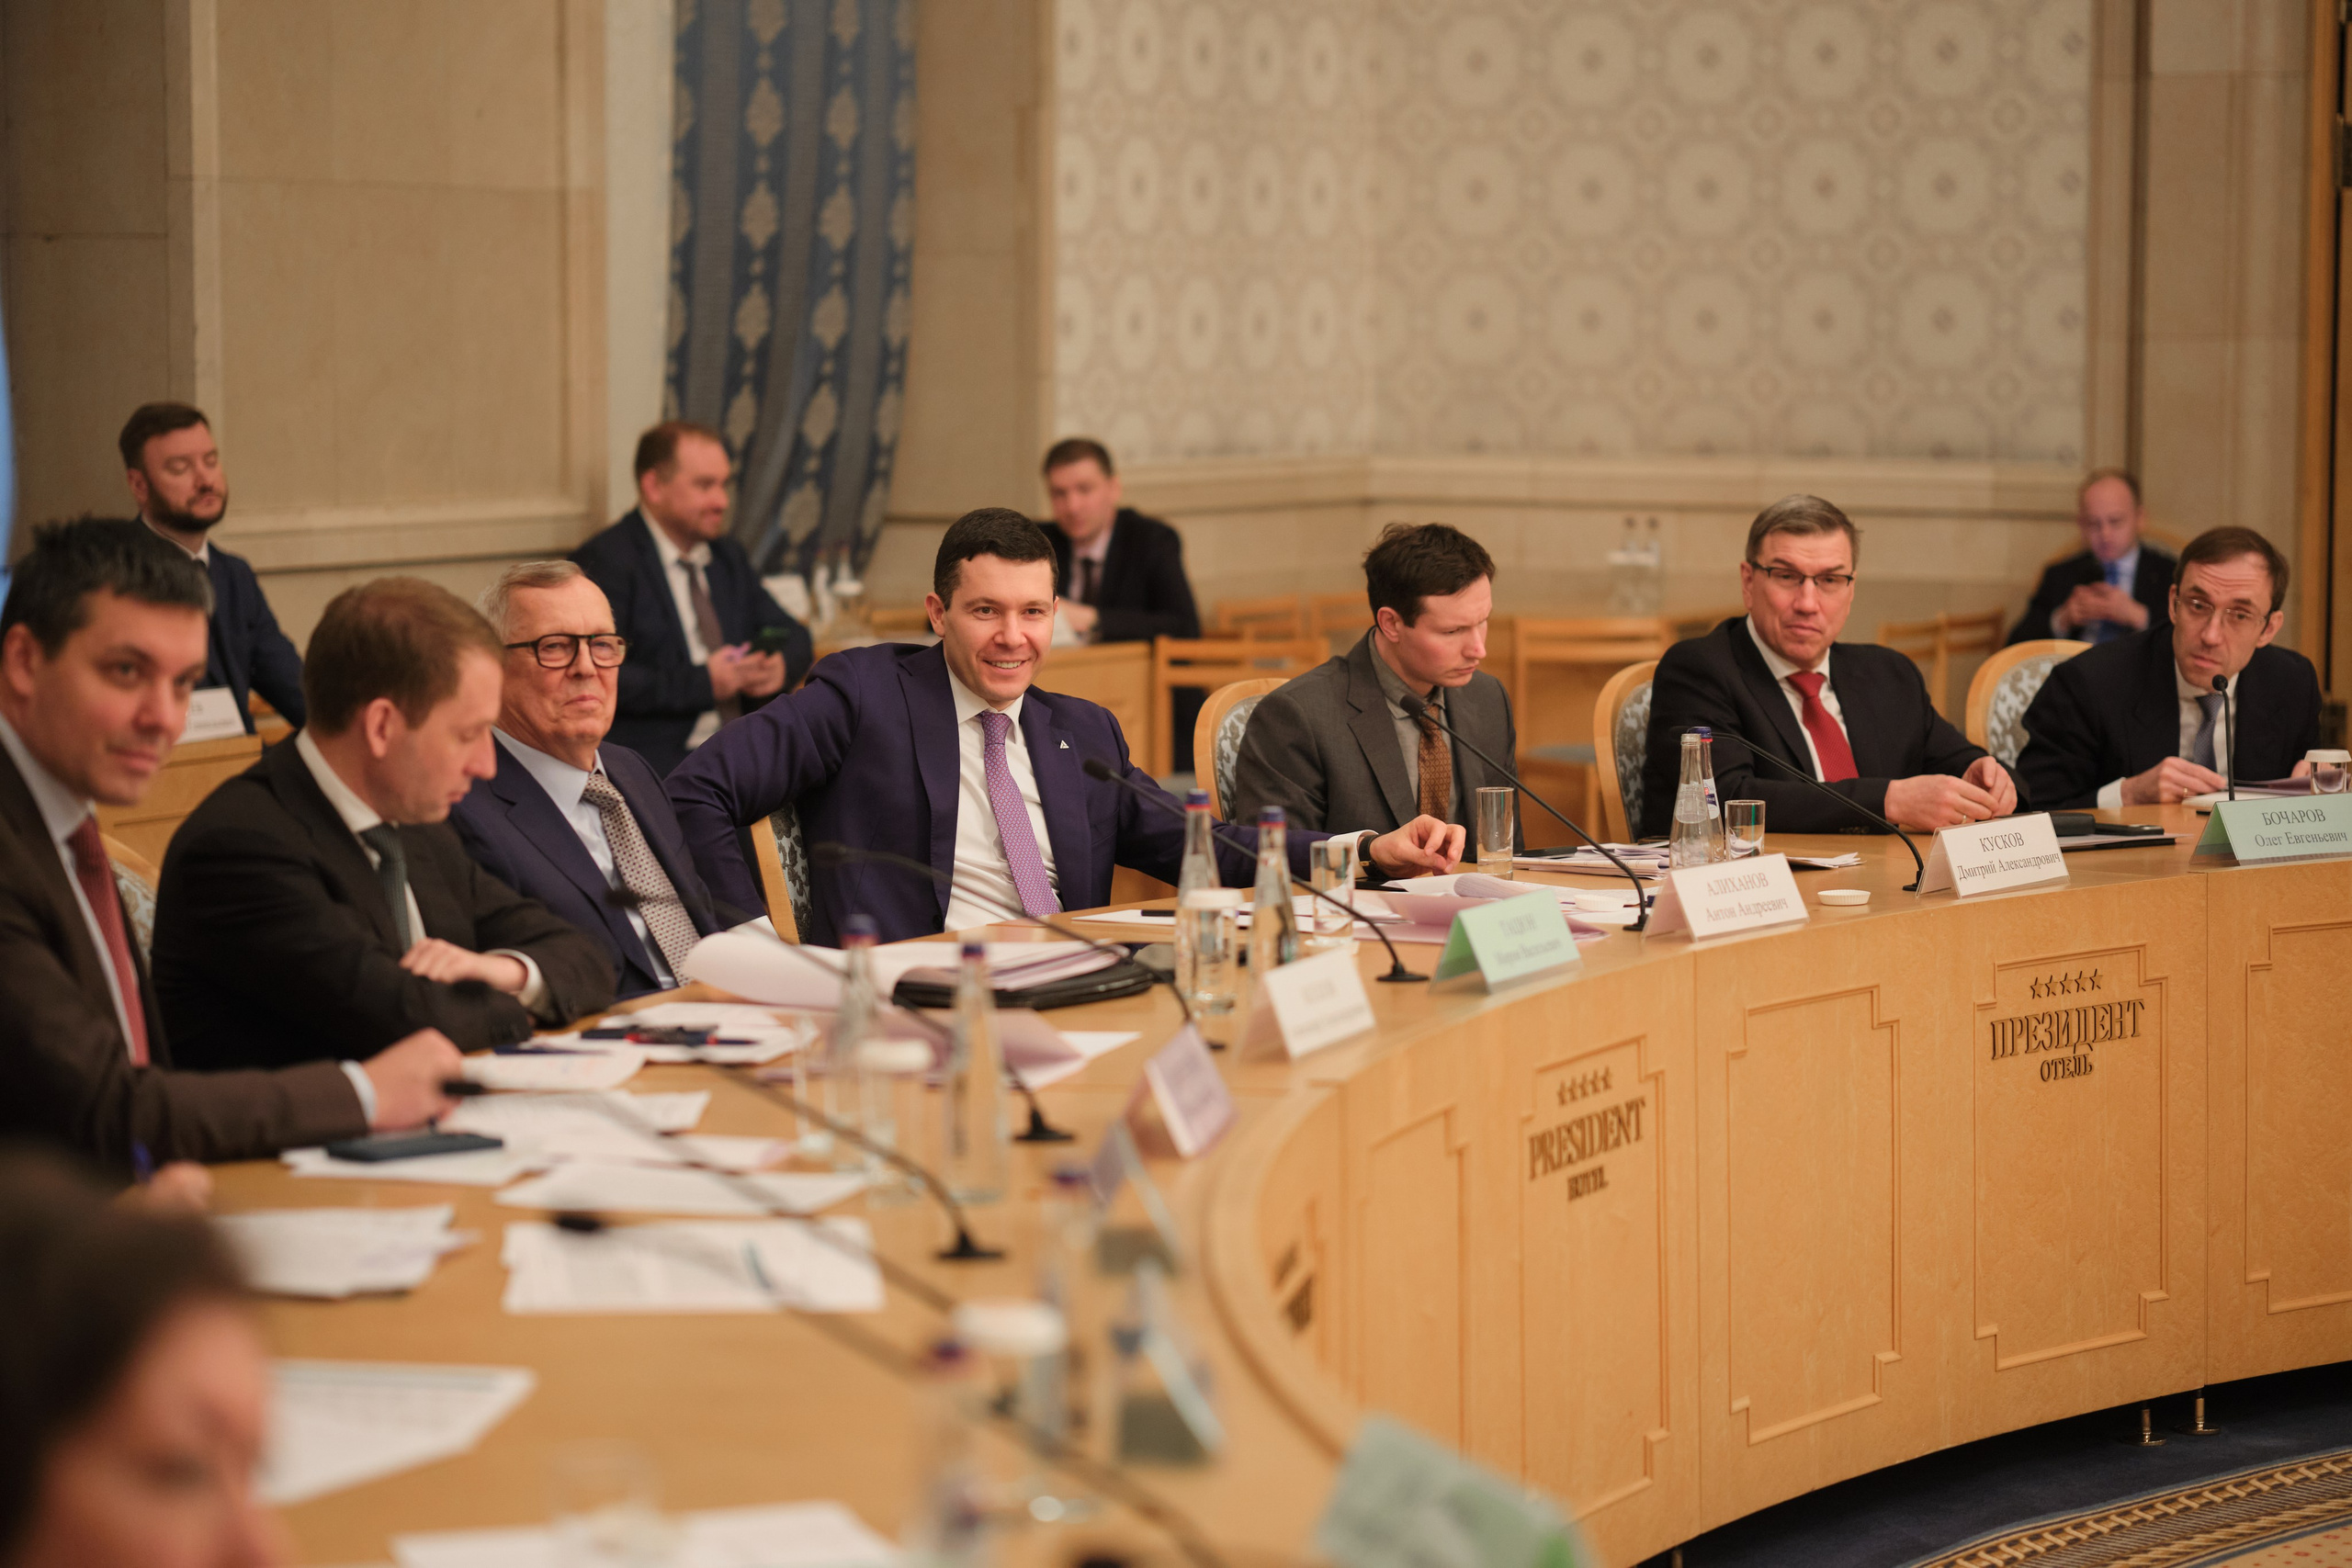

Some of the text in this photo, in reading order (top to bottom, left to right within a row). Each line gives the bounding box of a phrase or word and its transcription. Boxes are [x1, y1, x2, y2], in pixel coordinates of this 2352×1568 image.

[2261, 808, 2326, 826] БОЧАРОВ
[1979, 831, 2025, 852] КУСКОВ
[2254, 831, 2348, 847] Олег Евгеньевич
[1957, 852, 2062, 882] Дмитрий Александрович
[1706, 872, 1770, 897] АЛИХАНОВ
[1705, 897, 1790, 923] Антон Андреевич
[1990, 998, 2145, 1061] ПРЕЗИДЕНТ
[2040, 1053, 2095, 1083] ОТЕЛЬ
[1529, 1096, 1646, 1181] PRESIDENT
